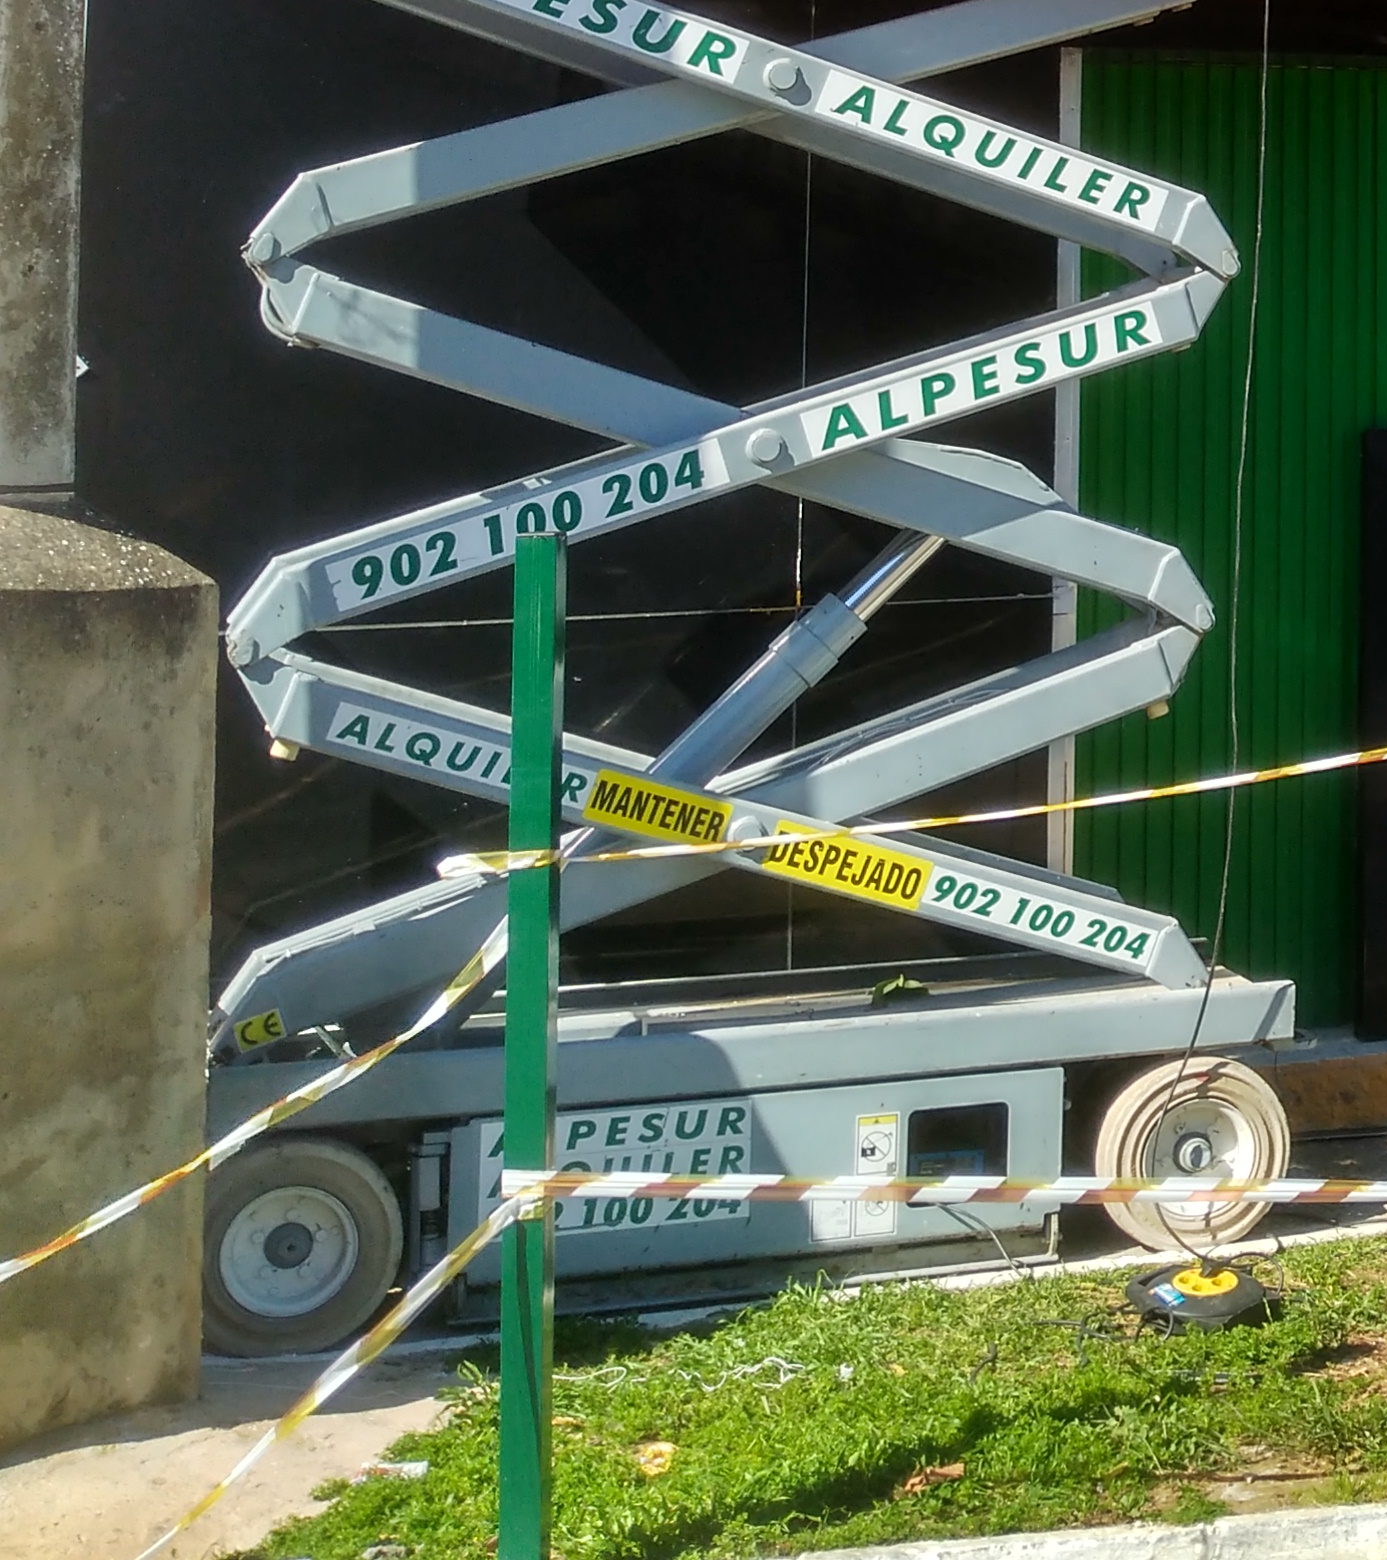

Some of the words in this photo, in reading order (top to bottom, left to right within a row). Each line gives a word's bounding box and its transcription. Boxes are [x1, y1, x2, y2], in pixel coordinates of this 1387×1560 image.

[834, 85, 1152, 220] ALQUILER
[821, 309, 1153, 452] ALPESUR
[351, 531, 459, 600] 902
[483, 490, 583, 556] 100
[602, 448, 704, 519] 204
[336, 714, 588, 804] ALQUIR
[590, 779, 725, 842] MANTENER
[768, 830, 922, 901] DESPEJADO
[931, 875, 1002, 918] 902
[1008, 896, 1077, 938] 100
[1078, 918, 1151, 960] 204
[241, 1012, 281, 1045] CE
[487, 1107, 746, 1158] PESUR
[583, 1197, 654, 1228] 100
